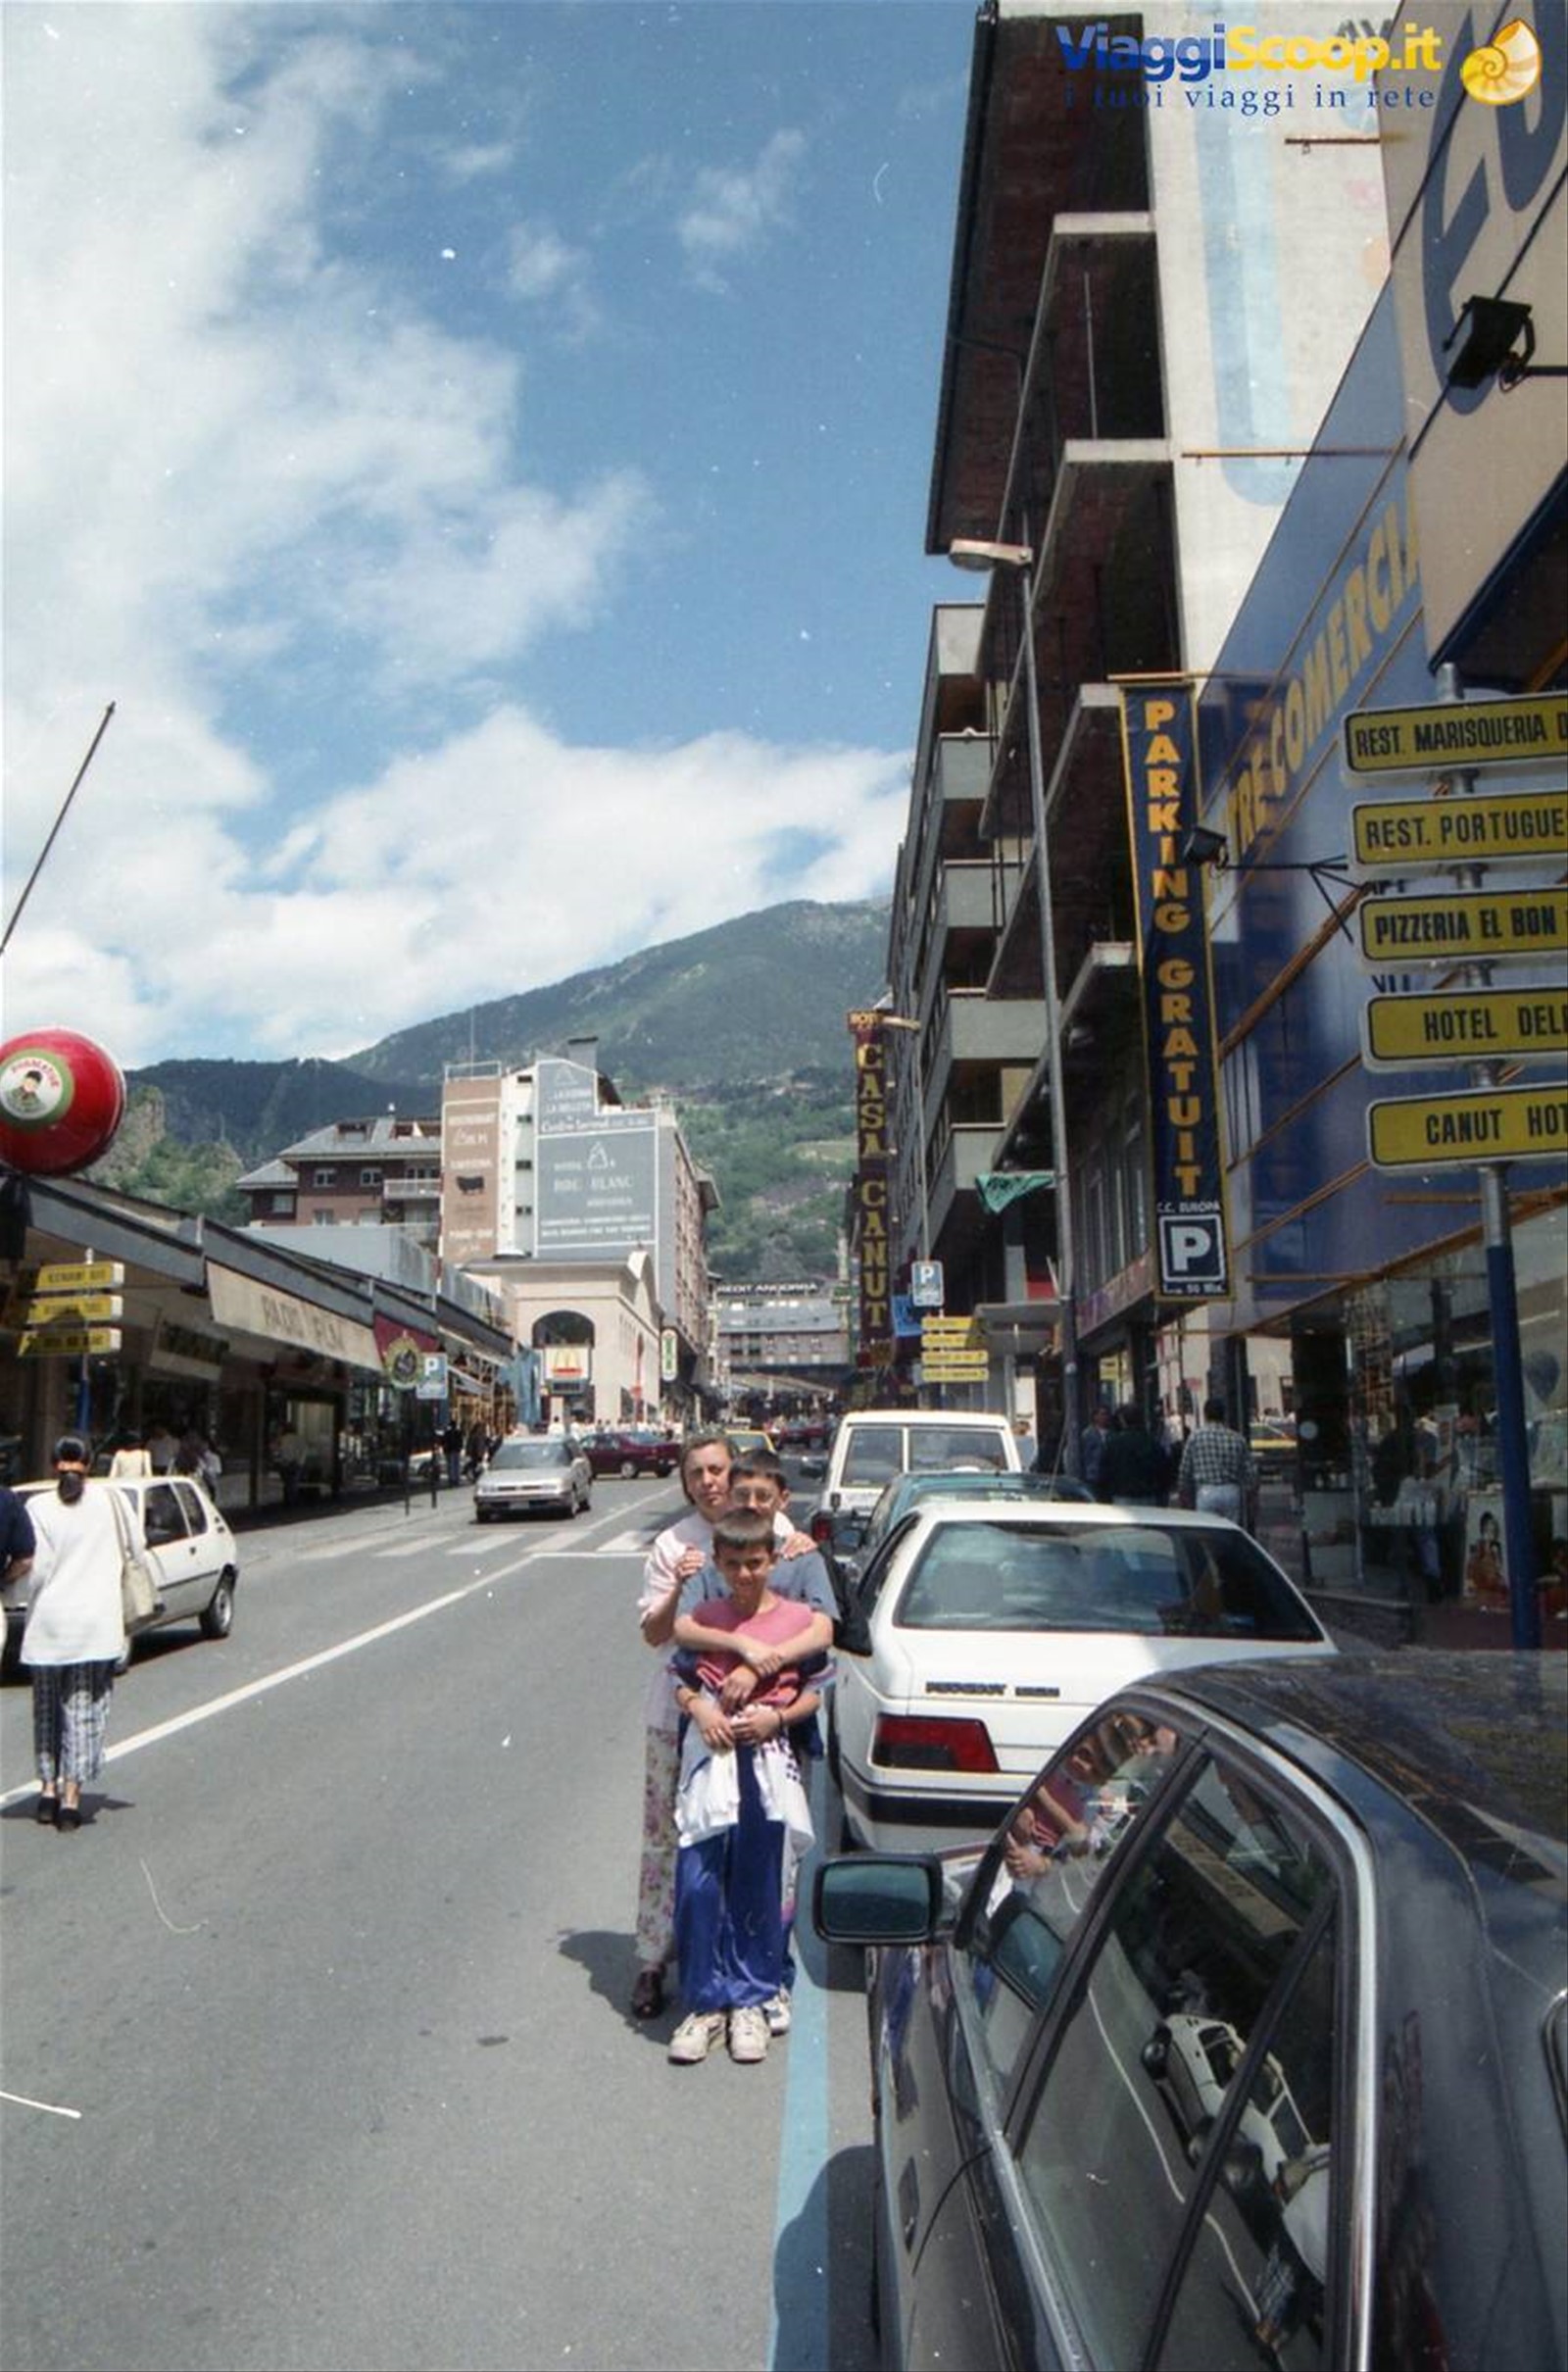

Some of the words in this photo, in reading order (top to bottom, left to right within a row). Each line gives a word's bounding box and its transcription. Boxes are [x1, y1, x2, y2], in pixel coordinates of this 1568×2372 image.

[1414, 713, 1547, 753] MARISQUERIA
[1144, 700, 1191, 932] PARKING
[1365, 816, 1431, 850] REST.
[1440, 807, 1568, 846] PORTUGUE
[1374, 911, 1470, 946] PIZZERIA
[1480, 908, 1503, 939] EL
[1510, 905, 1558, 937] BON
[1424, 1008, 1497, 1043] HOTEL
[1157, 959, 1201, 1196] GRATUIT
[858, 1044, 886, 1160] CASA
[1425, 1109, 1502, 1146] CANUT
[1179, 1201, 1221, 1213] EUROPA
[861, 1179, 888, 1328] CANUT
[1170, 1225, 1212, 1271] P
[921, 1264, 935, 1284] P
[424, 1357, 440, 1376] P
